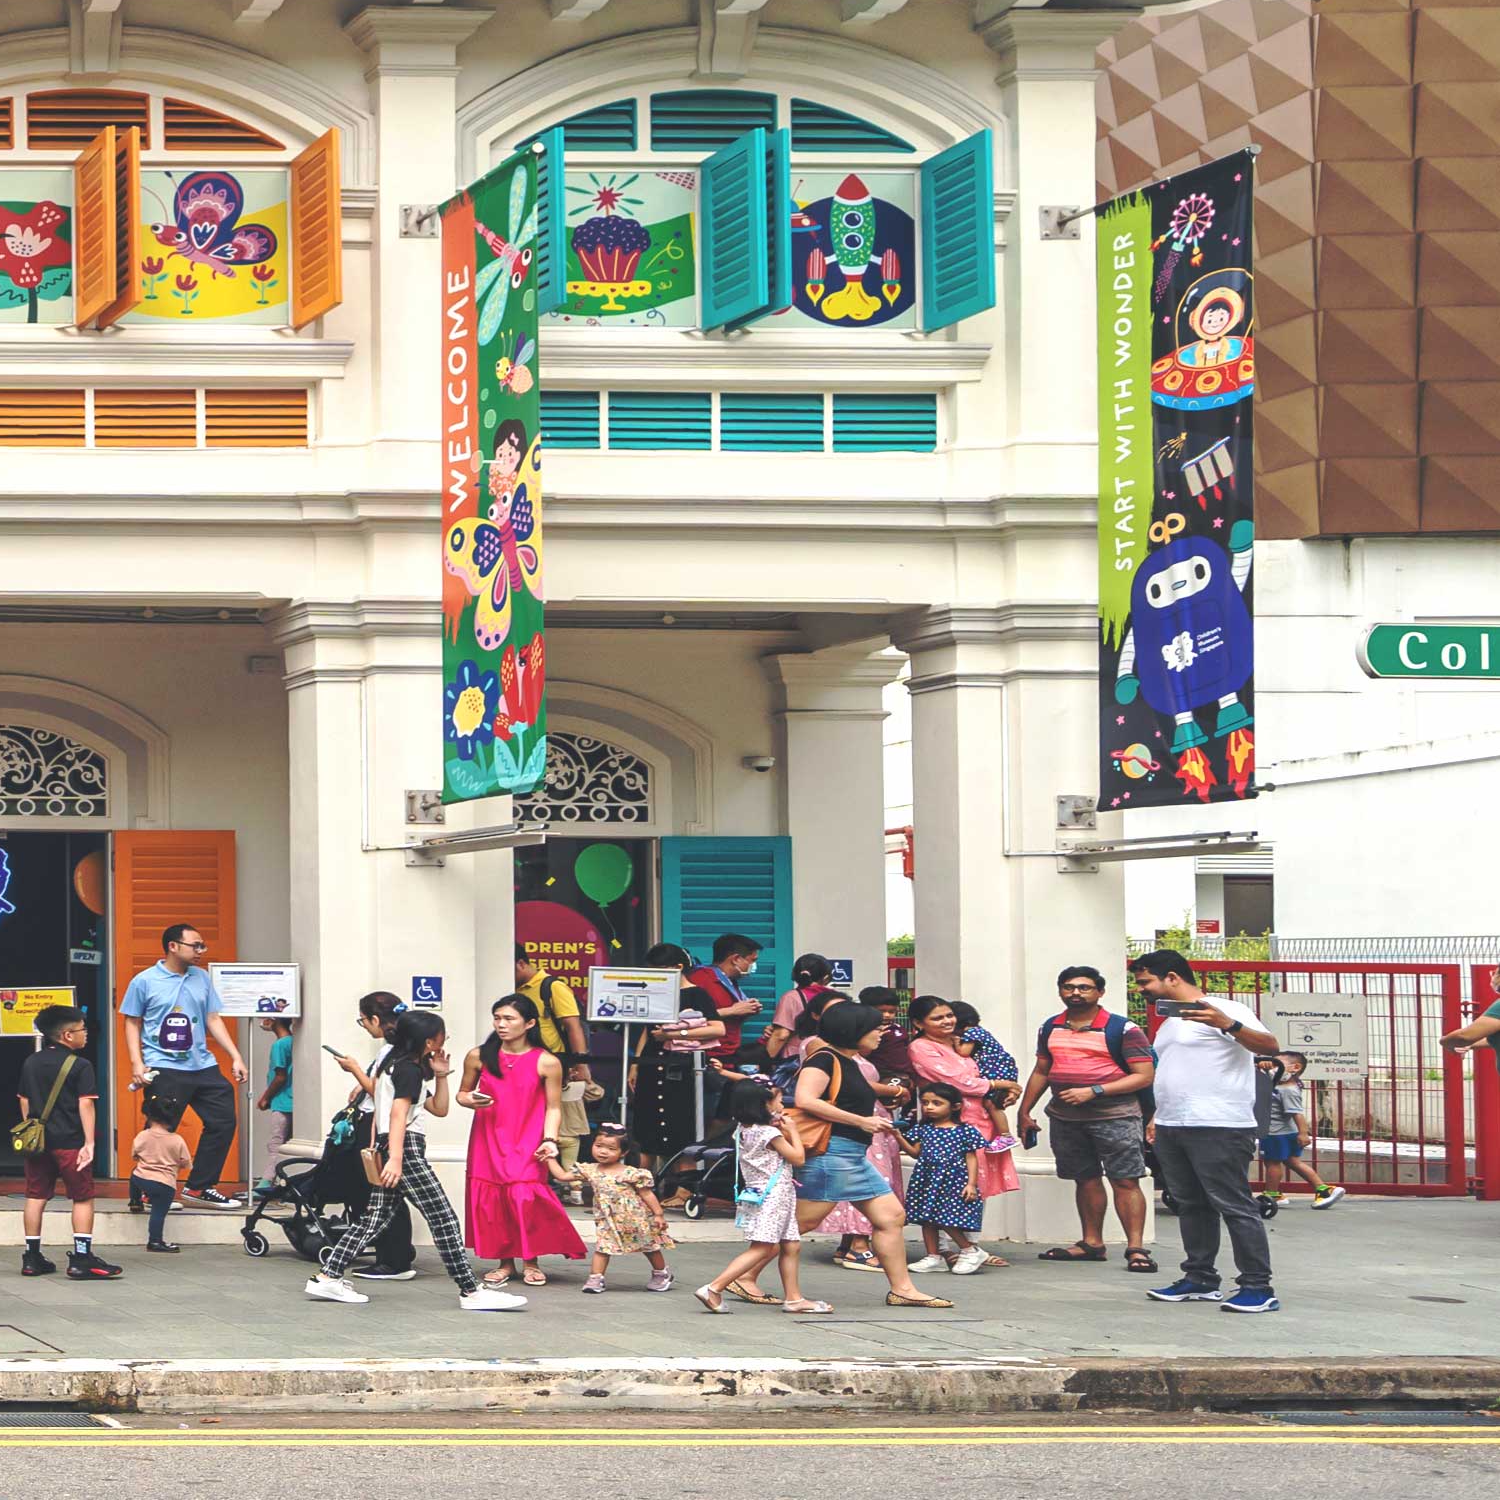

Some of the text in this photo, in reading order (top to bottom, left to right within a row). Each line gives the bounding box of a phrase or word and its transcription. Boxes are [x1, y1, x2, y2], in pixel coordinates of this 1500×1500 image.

[446, 265, 472, 513] WELCOME
[1113, 232, 1135, 571] START WITH WONDER
[524, 941, 596, 954] DREN'S
[528, 959, 580, 970] SEUM
